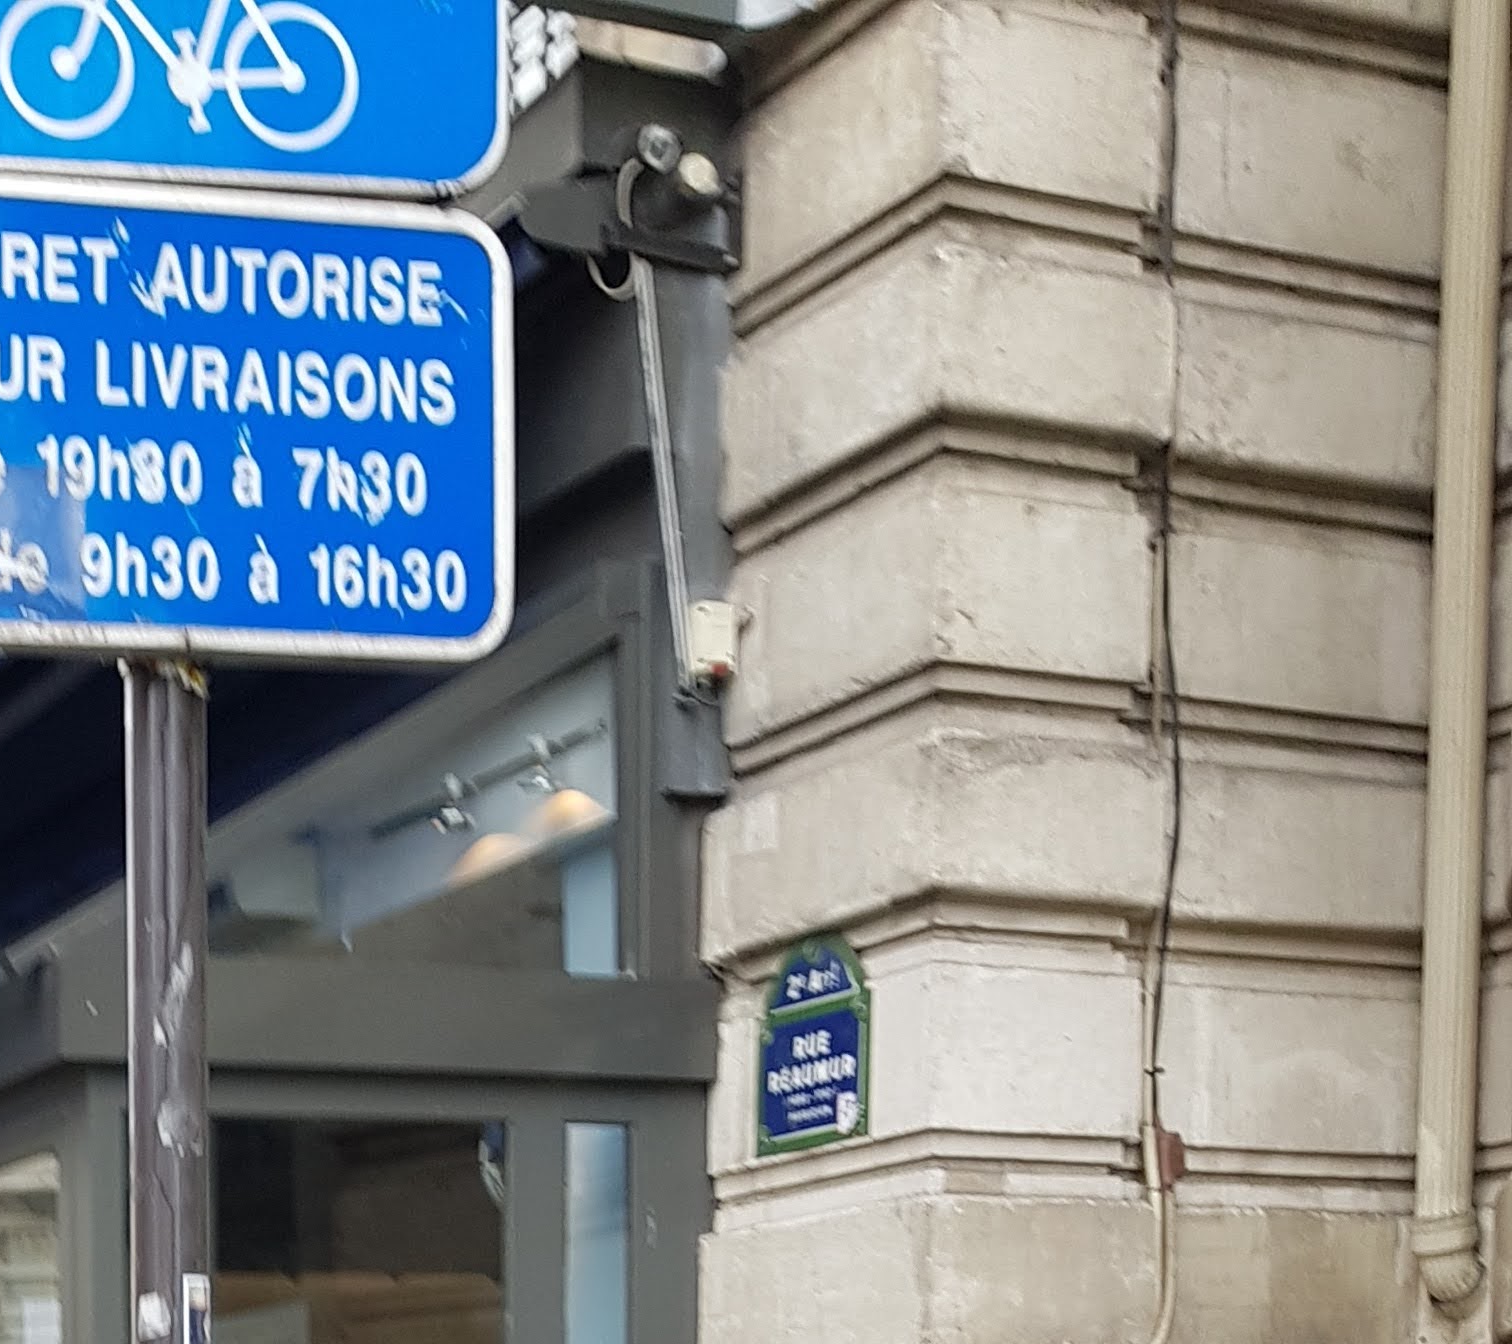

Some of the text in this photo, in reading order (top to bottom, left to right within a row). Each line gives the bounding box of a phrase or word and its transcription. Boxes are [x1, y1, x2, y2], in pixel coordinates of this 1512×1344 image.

[148, 241, 444, 327] AUTORISE
[95, 338, 458, 426] LIVRAISONS
[232, 424, 263, 508] à
[292, 446, 427, 518] 7h30
[80, 531, 220, 602] 9h30
[249, 533, 280, 605] à
[309, 543, 467, 613] 16h30
[792, 1029, 832, 1061] RUE
